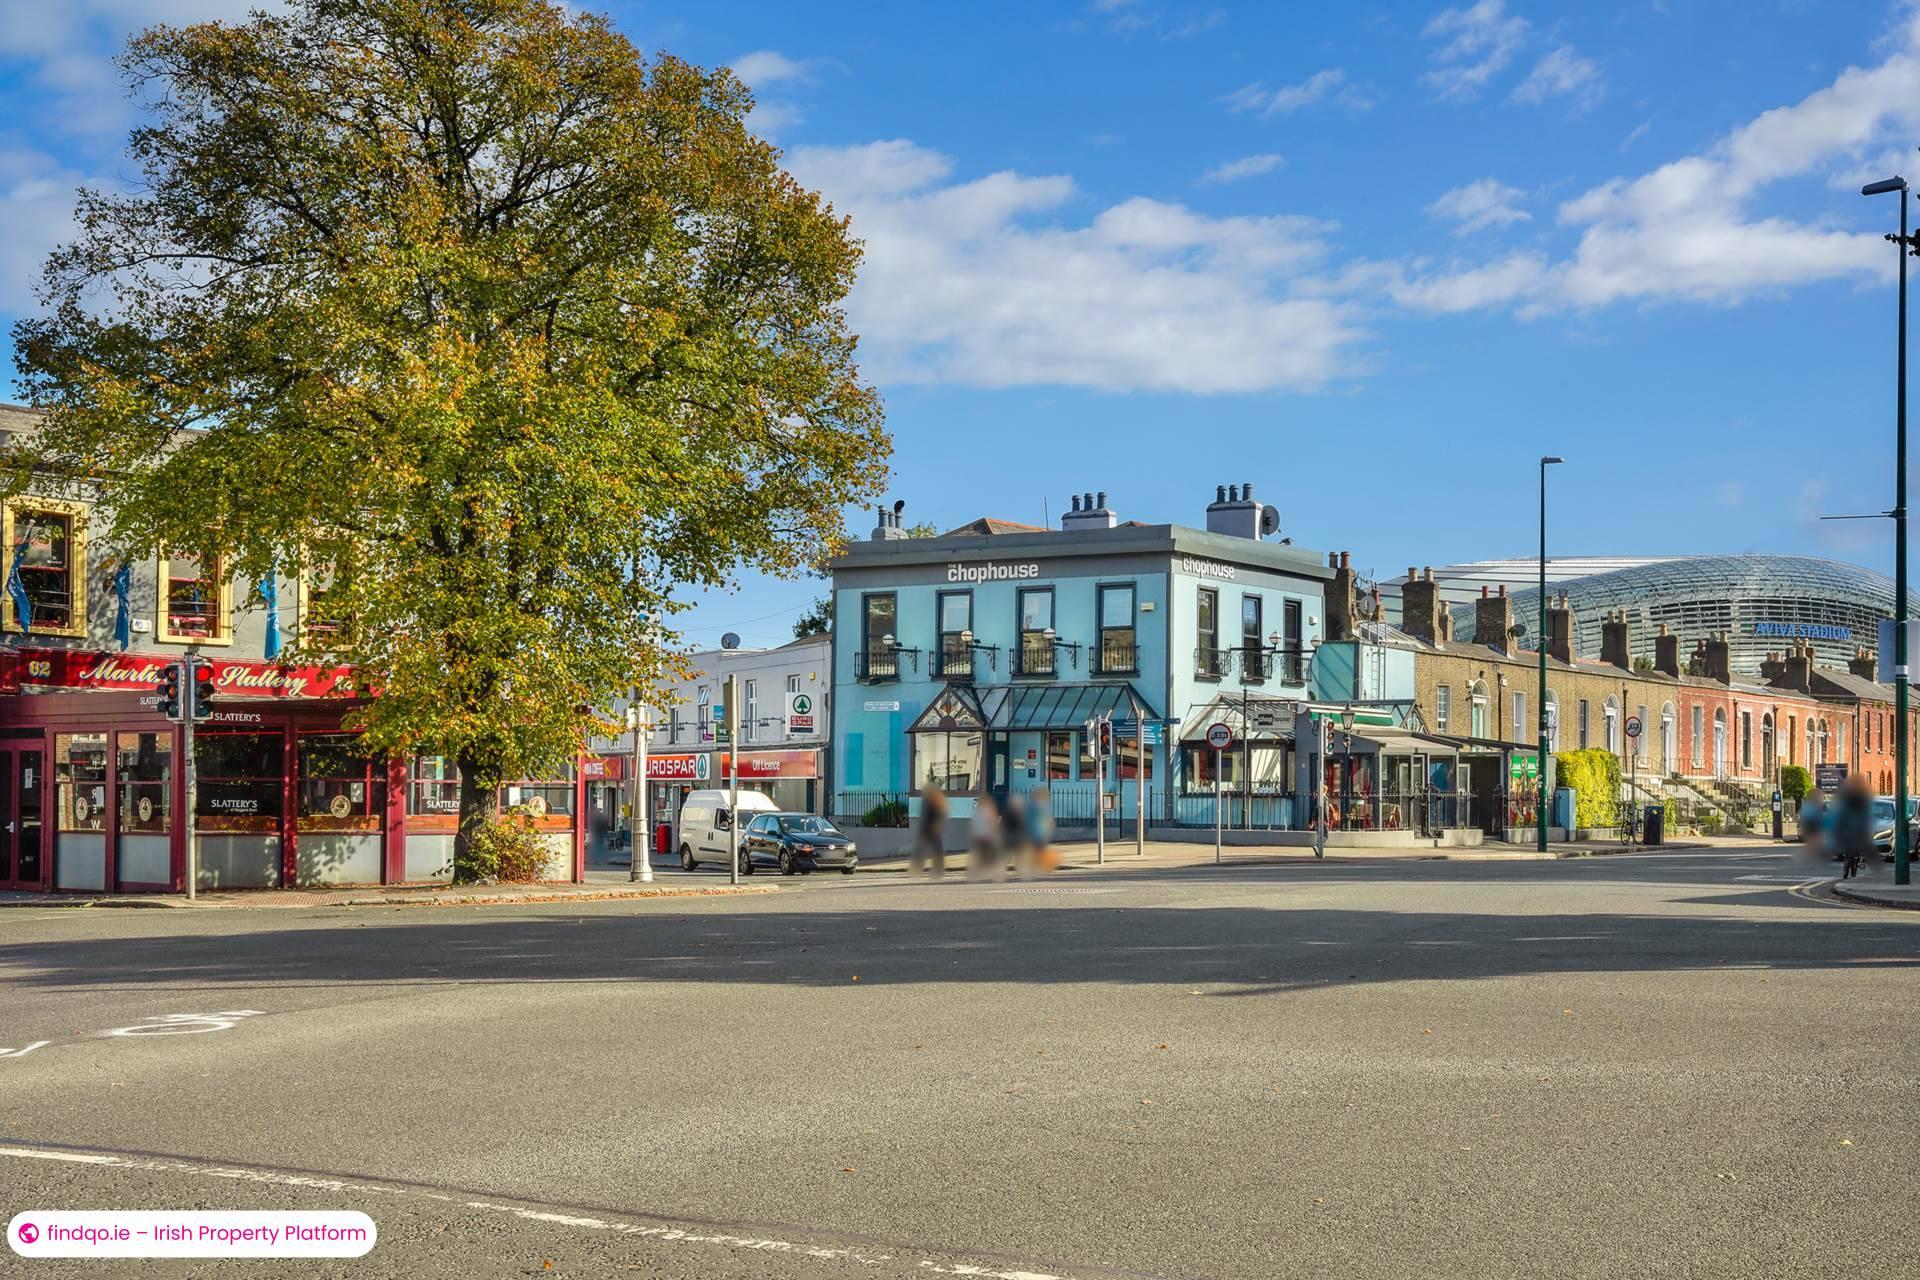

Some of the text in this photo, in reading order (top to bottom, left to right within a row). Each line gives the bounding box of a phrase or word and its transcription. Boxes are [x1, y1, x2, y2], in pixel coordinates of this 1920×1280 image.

[948, 562, 1039, 584] chophouse
[1183, 557, 1235, 579] chophouse
[1756, 622, 1854, 640] AVIVA STADIUM
[29, 661, 51, 678] 62
[79, 657, 166, 684] Marti
[217, 665, 308, 697] Slattery
[214, 712, 261, 722] SLATTERY'S
[646, 759, 696, 775] UROSPAR
[211, 799, 258, 808] SLATTERY'S
[426, 800, 461, 809] SLATTERY
